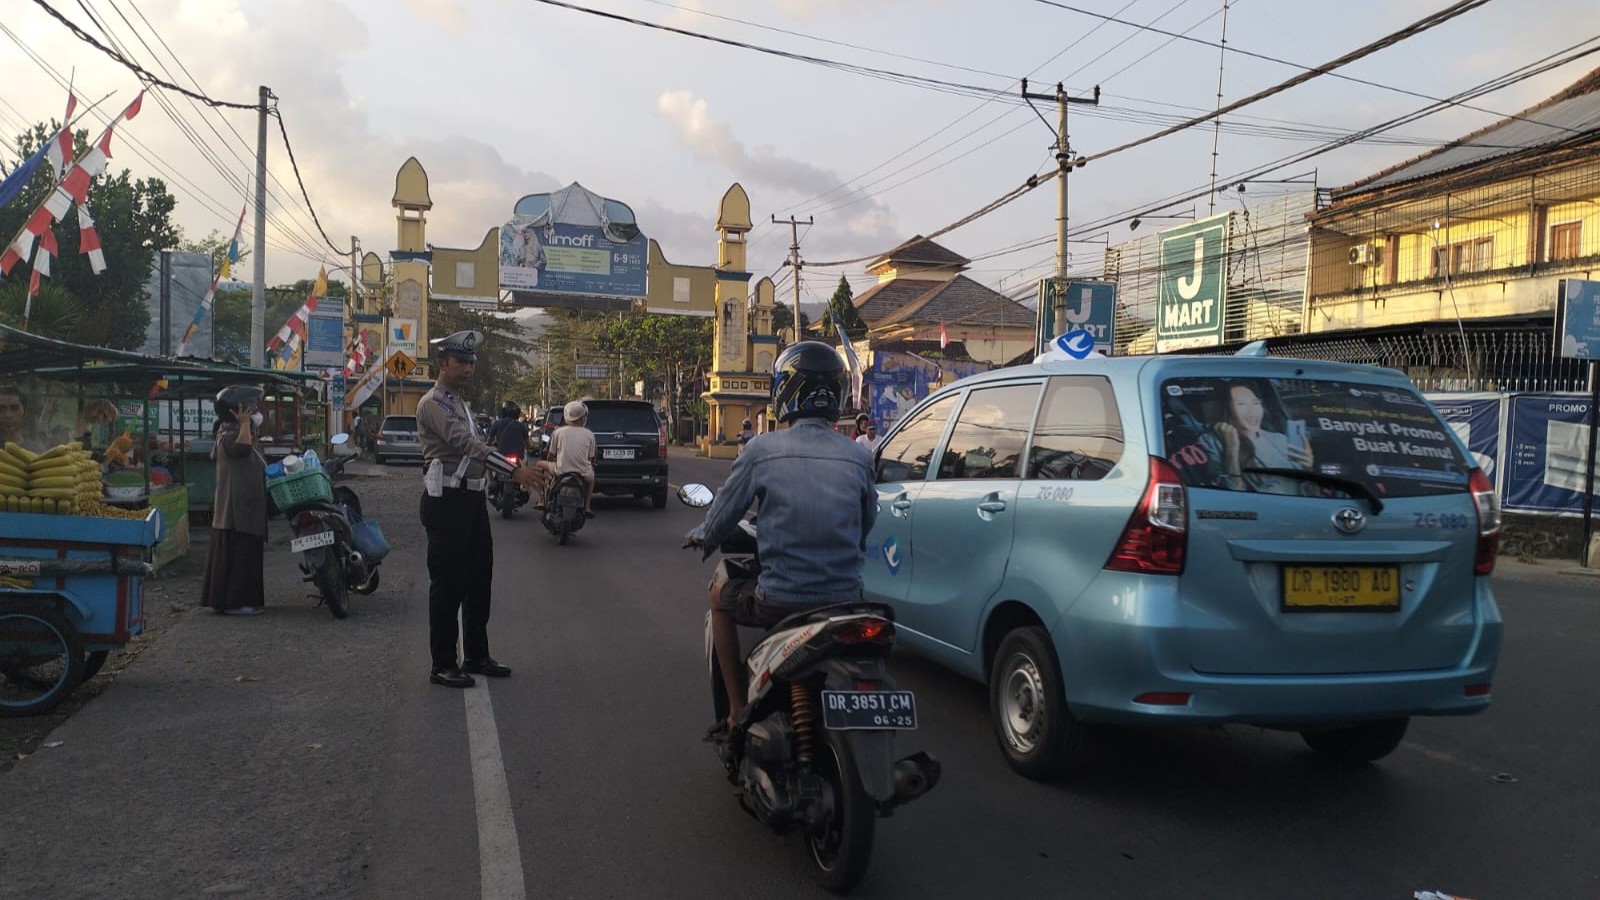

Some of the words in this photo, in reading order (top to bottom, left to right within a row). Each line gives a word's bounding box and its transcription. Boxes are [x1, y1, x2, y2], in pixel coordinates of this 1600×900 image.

[613, 253, 628, 263] 6-9
[1178, 236, 1204, 300] J
[1066, 288, 1093, 324] J
[1164, 299, 1213, 328] MART
[1549, 404, 1587, 413] PROMO
[1318, 417, 1388, 436] Banyak
[1389, 422, 1445, 442] Promo
[1353, 437, 1398, 454] Buat
[1399, 441, 1454, 460] Kamu!
[1413, 512, 1438, 527] ZG
[1440, 513, 1468, 529] 080
[829, 694, 846, 710] DR
[850, 694, 886, 710] 3851
[890, 694, 911, 710] CM
